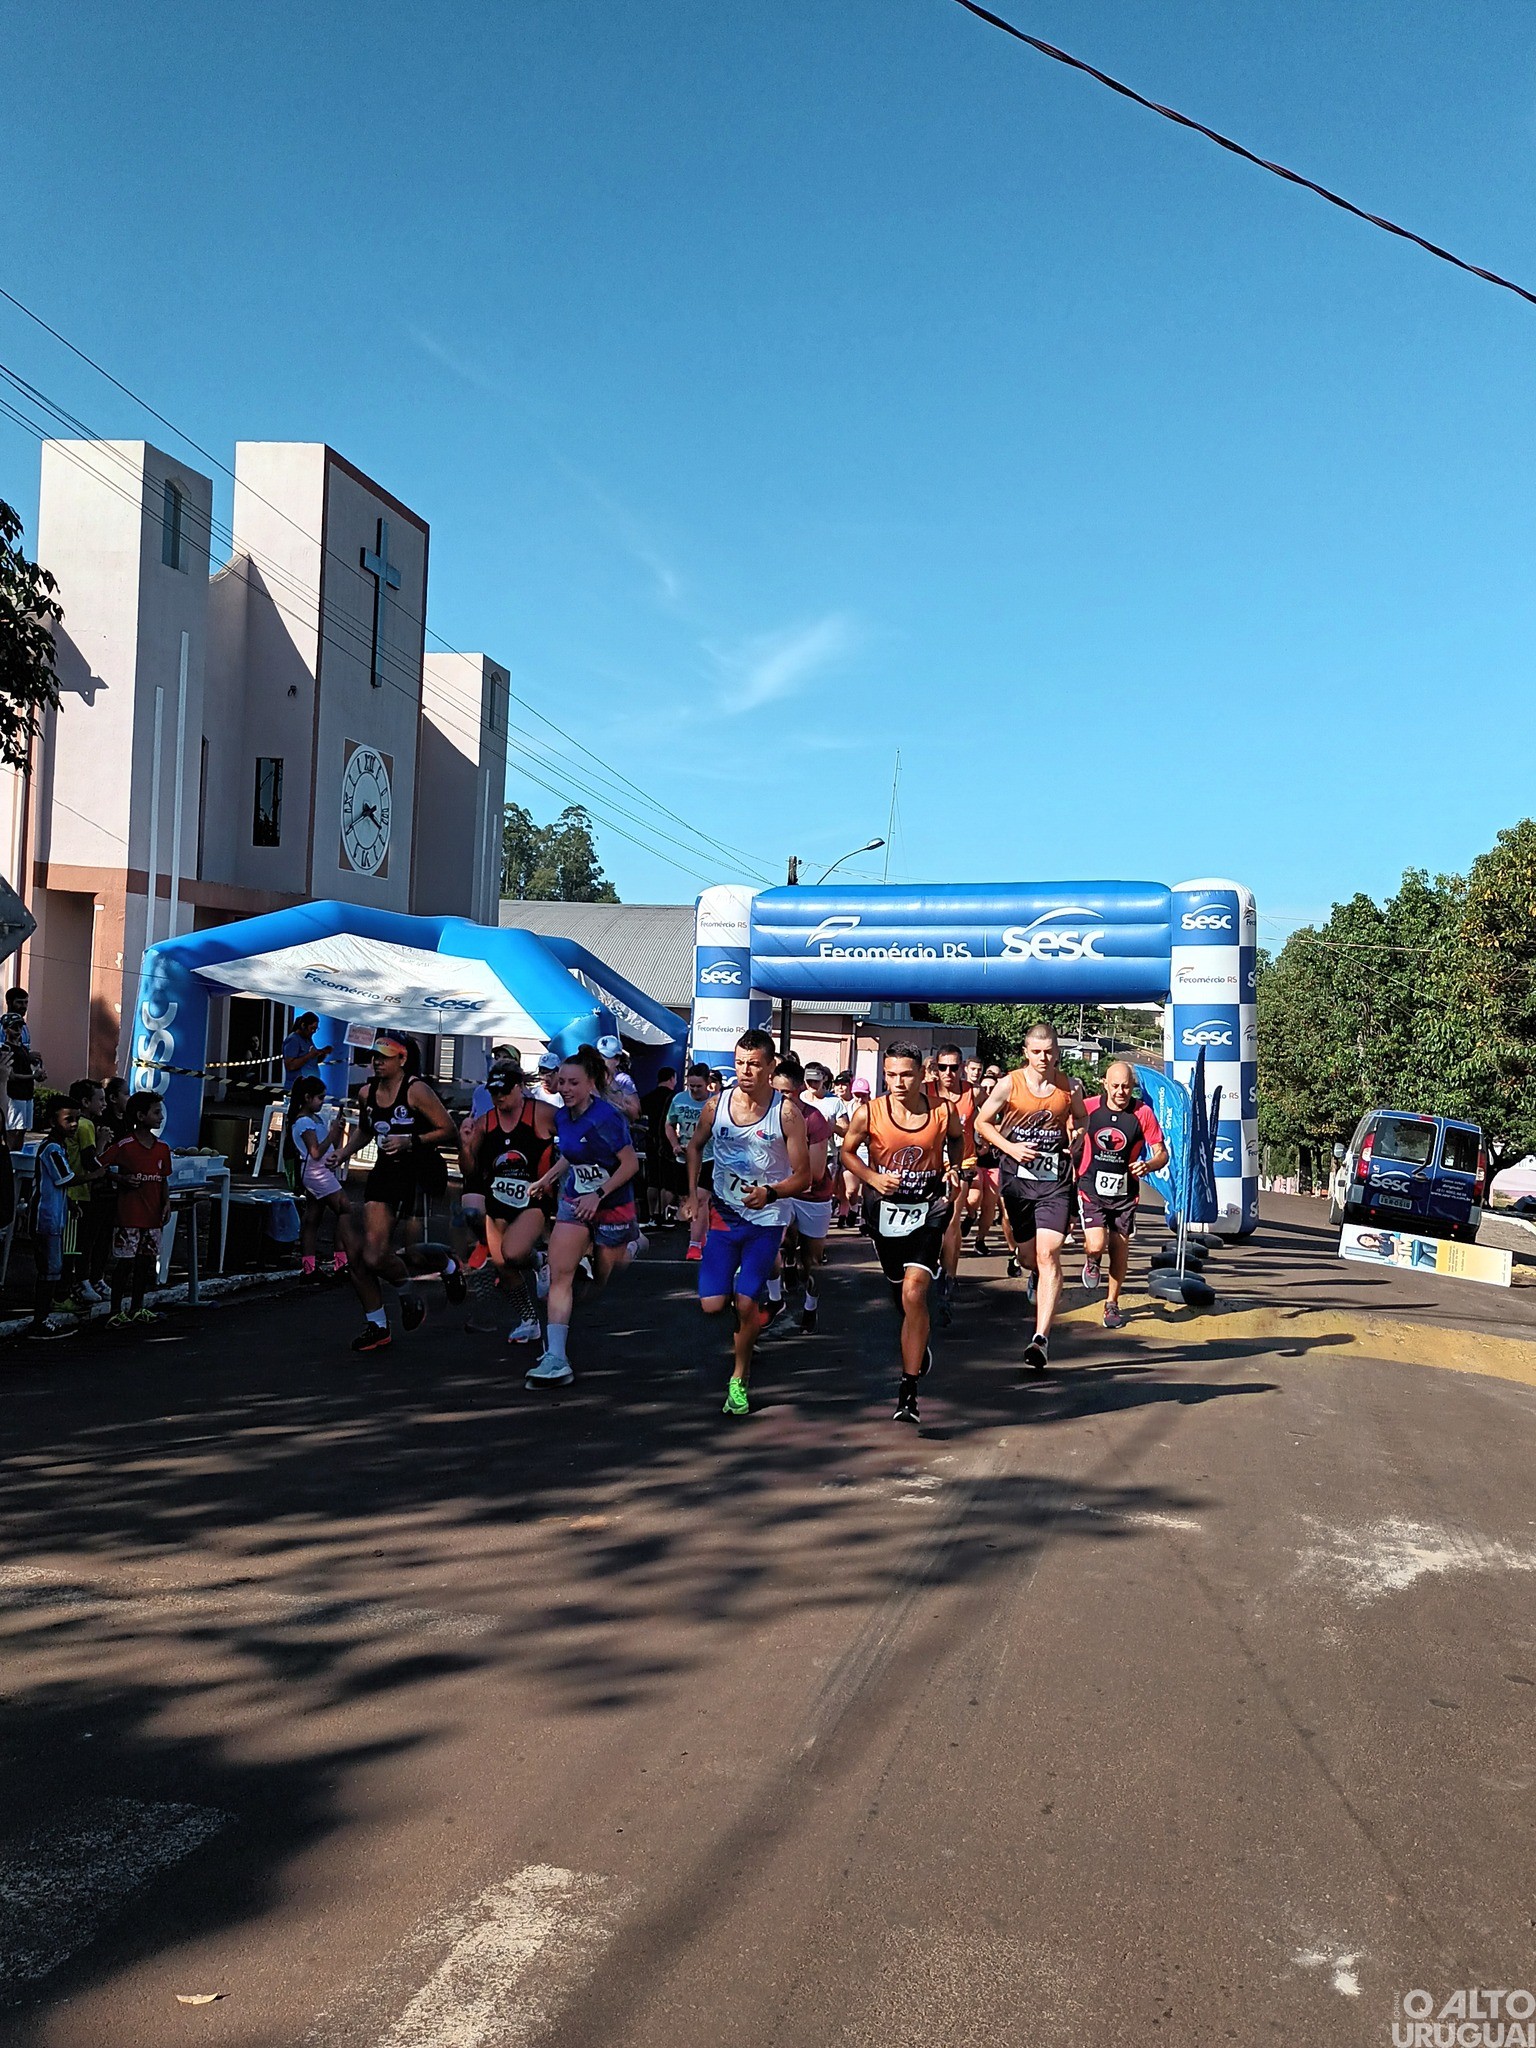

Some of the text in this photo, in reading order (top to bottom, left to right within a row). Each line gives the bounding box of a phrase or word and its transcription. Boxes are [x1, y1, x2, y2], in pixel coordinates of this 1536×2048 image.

[700, 919, 748, 929] Fecomércio RS
[1181, 912, 1232, 930] Sesc
[820, 941, 972, 960] Fecomércio RS
[1000, 924, 1106, 962] Sesc
[700, 968, 742, 985] Sesc
[1179, 974, 1238, 984] Fecomércio RS
[304, 971, 402, 1005] Fecomércio RS
[421, 995, 486, 1011] Sesc
[697, 1024, 746, 1034] Fecomércio RS
[1182, 1028, 1233, 1046] Sesc
[1213, 1147, 1234, 1162] sc
[576, 1166, 604, 1184] 944
[1100, 1176, 1125, 1190] 875
[1369, 1173, 1411, 1193] Sesc
[886, 1207, 922, 1226] 773
